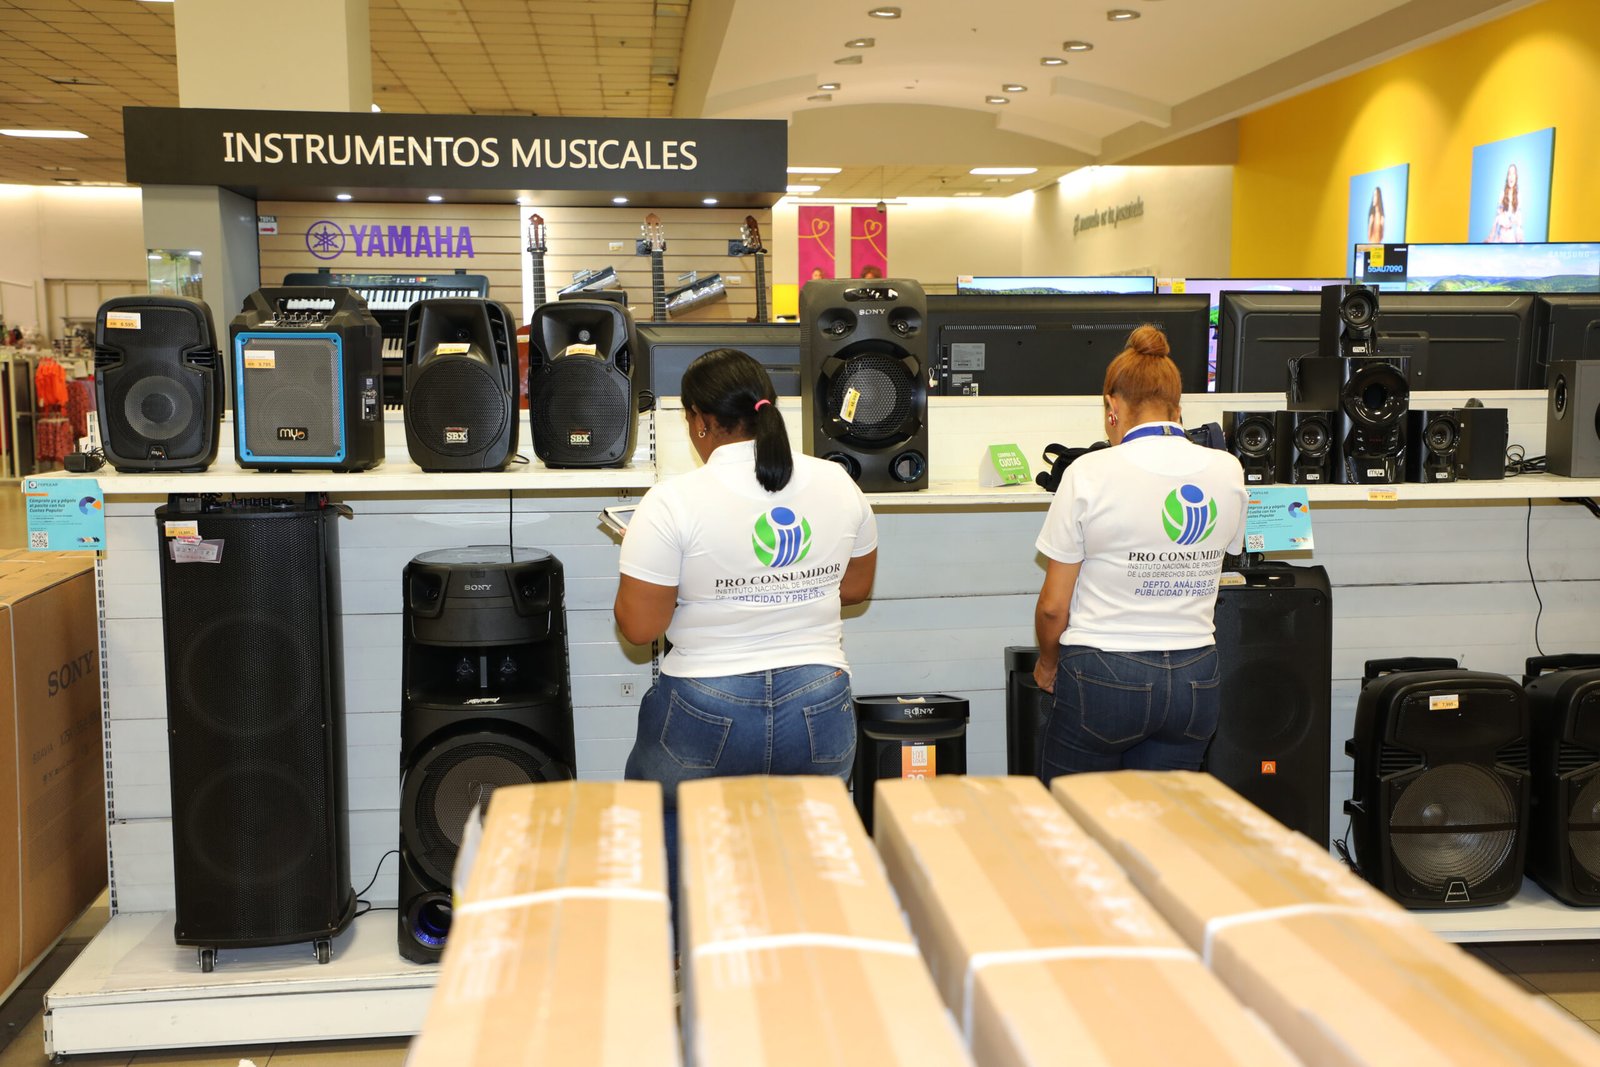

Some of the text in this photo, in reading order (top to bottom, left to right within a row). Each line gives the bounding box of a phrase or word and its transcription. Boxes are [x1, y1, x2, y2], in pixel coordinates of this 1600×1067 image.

[223, 132, 697, 170] INSTRUMENTOS MUSICALES
[349, 225, 475, 258] YAMAHA
[858, 308, 886, 316] SONY
[446, 432, 466, 440] SBX
[570, 434, 590, 443] SBX
[998, 457, 1021, 468] CUOTAS
[1128, 552, 1156, 562] PRO
[1127, 563, 1161, 571] INSTITUTO
[1161, 562, 1191, 570] NACIONAL
[715, 563, 841, 588] PRO CONSUMIDOR
[1138, 571, 1151, 579] LOS
[1152, 570, 1185, 579] DERECHOS
[715, 587, 753, 595] INSTITUTO
[755, 583, 790, 593] NACIONAL
[1142, 581, 1172, 590] DEPTO.
[1173, 579, 1207, 589] ANÁLISIS
[1207, 578, 1216, 587] DE
[1134, 588, 1183, 598] PUBLICIDAD
[1184, 588, 1191, 597] Y
[784, 595, 790, 603] Y
[47, 649, 94, 698] SONY
[903, 707, 935, 716] SONY
